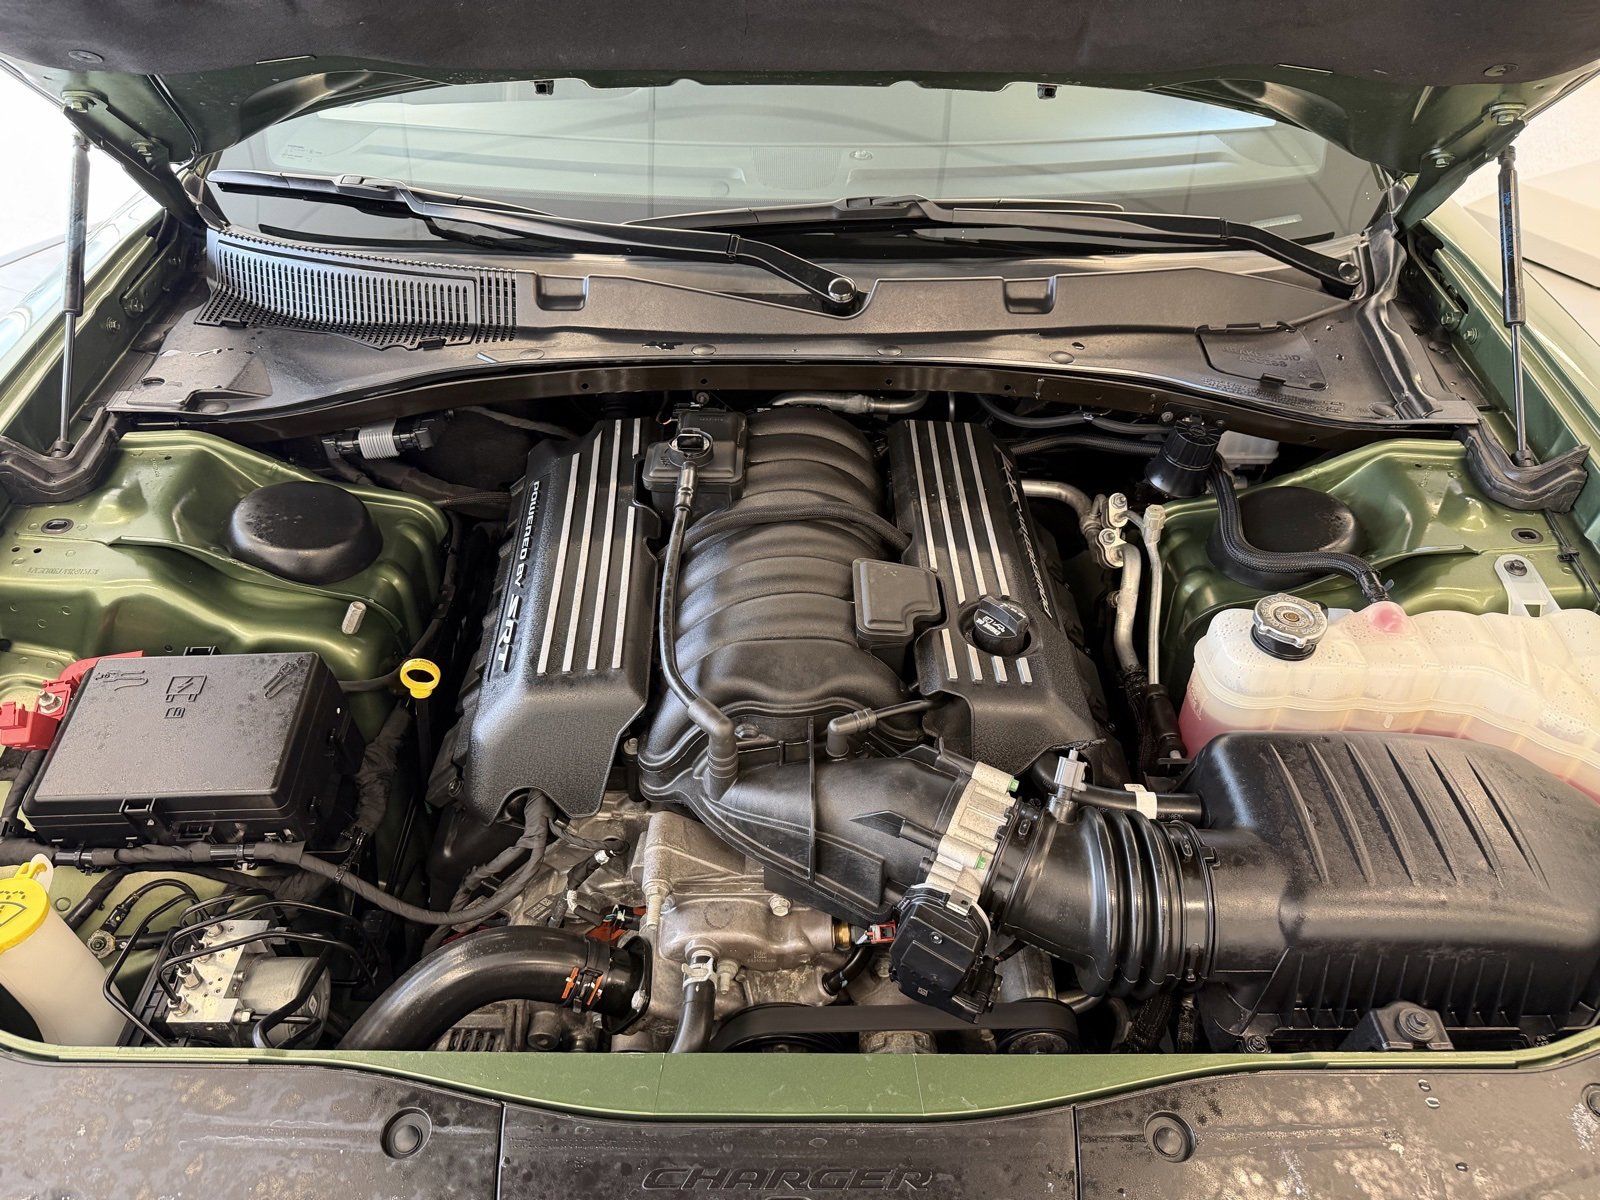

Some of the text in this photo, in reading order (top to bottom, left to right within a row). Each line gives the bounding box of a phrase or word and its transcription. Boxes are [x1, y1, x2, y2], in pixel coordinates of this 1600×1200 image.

[498, 480, 540, 672] POWERED BY SRT
[641, 1167, 933, 1190] CHARGER
